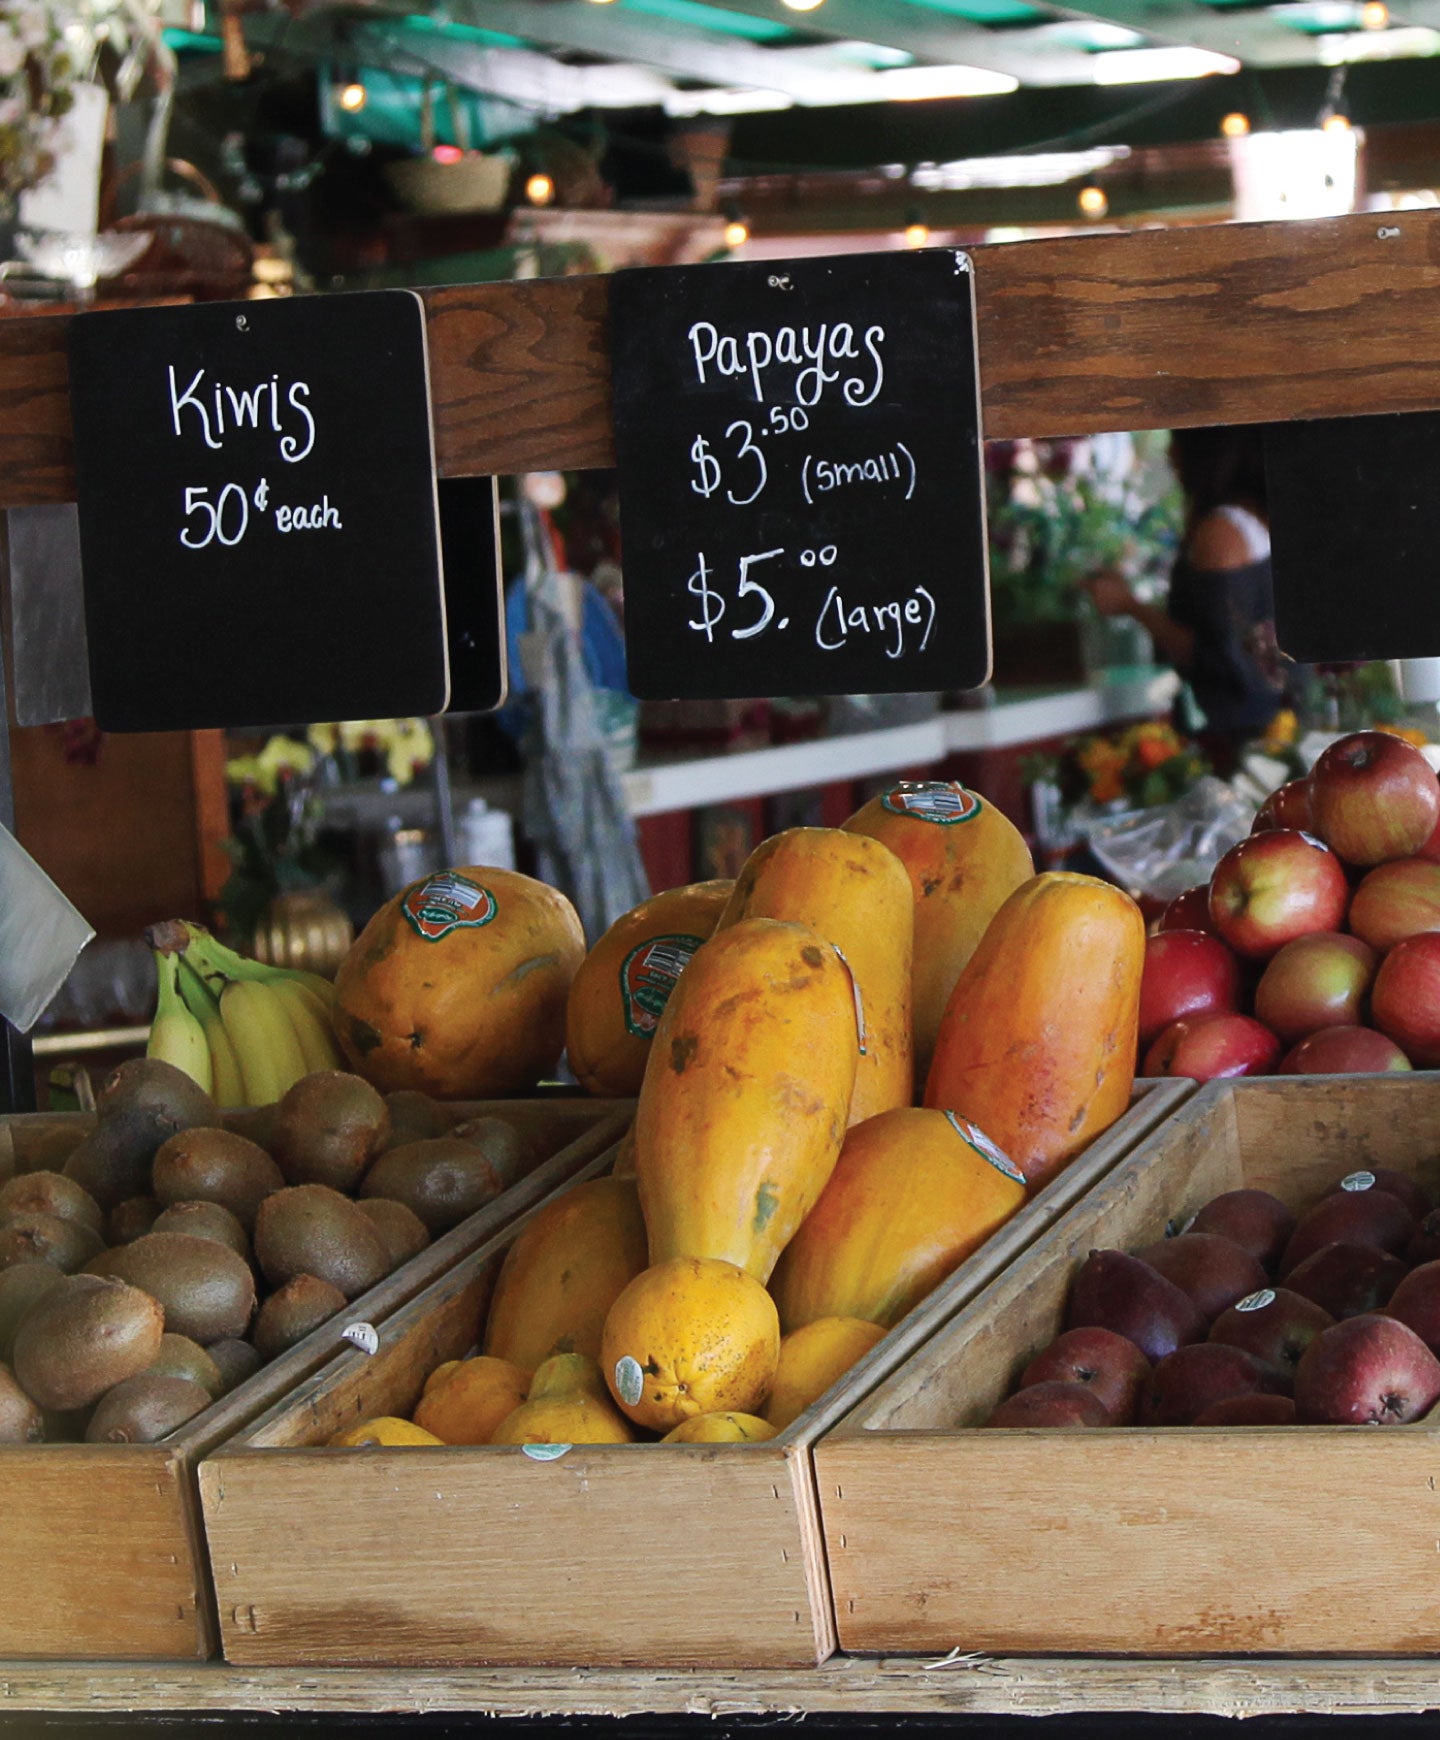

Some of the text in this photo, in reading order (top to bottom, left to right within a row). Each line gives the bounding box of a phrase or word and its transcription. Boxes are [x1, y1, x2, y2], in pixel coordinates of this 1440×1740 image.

[687, 321, 885, 407] Papayas
[168, 365, 315, 463] Kiwis
[691, 405, 809, 505] $3.50
[179, 477, 342, 549] 50¢ each
[814, 584, 936, 658] (large)
